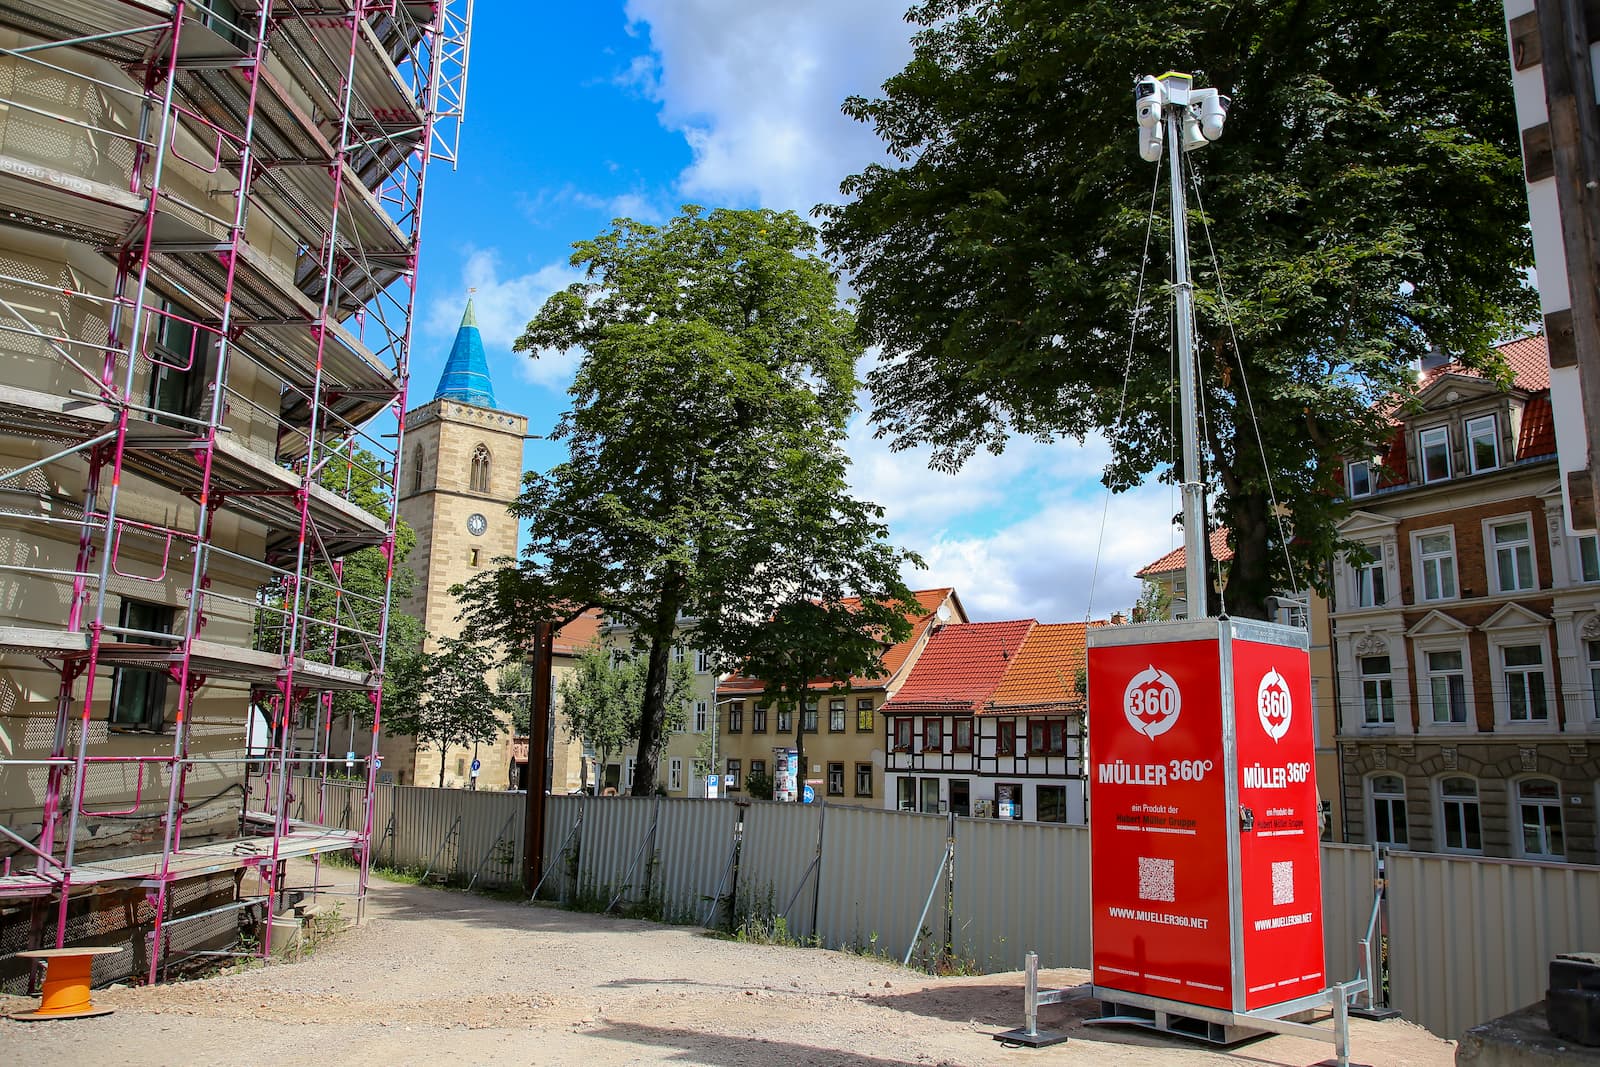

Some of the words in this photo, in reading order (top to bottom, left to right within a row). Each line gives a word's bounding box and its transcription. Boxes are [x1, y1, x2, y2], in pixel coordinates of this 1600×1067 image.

[1130, 688, 1175, 715] 360
[1262, 691, 1287, 717] 360
[1099, 760, 1167, 785] MÜLLER
[1244, 765, 1286, 788] MÜLLER
[1131, 804, 1141, 812] ein
[1143, 804, 1166, 813] Produkt
[1168, 805, 1179, 814] der
[1142, 815, 1166, 824] Müller
[1168, 817, 1197, 827] Gruppe
[1109, 906, 1209, 930] WWW.MUELLER360.NET
